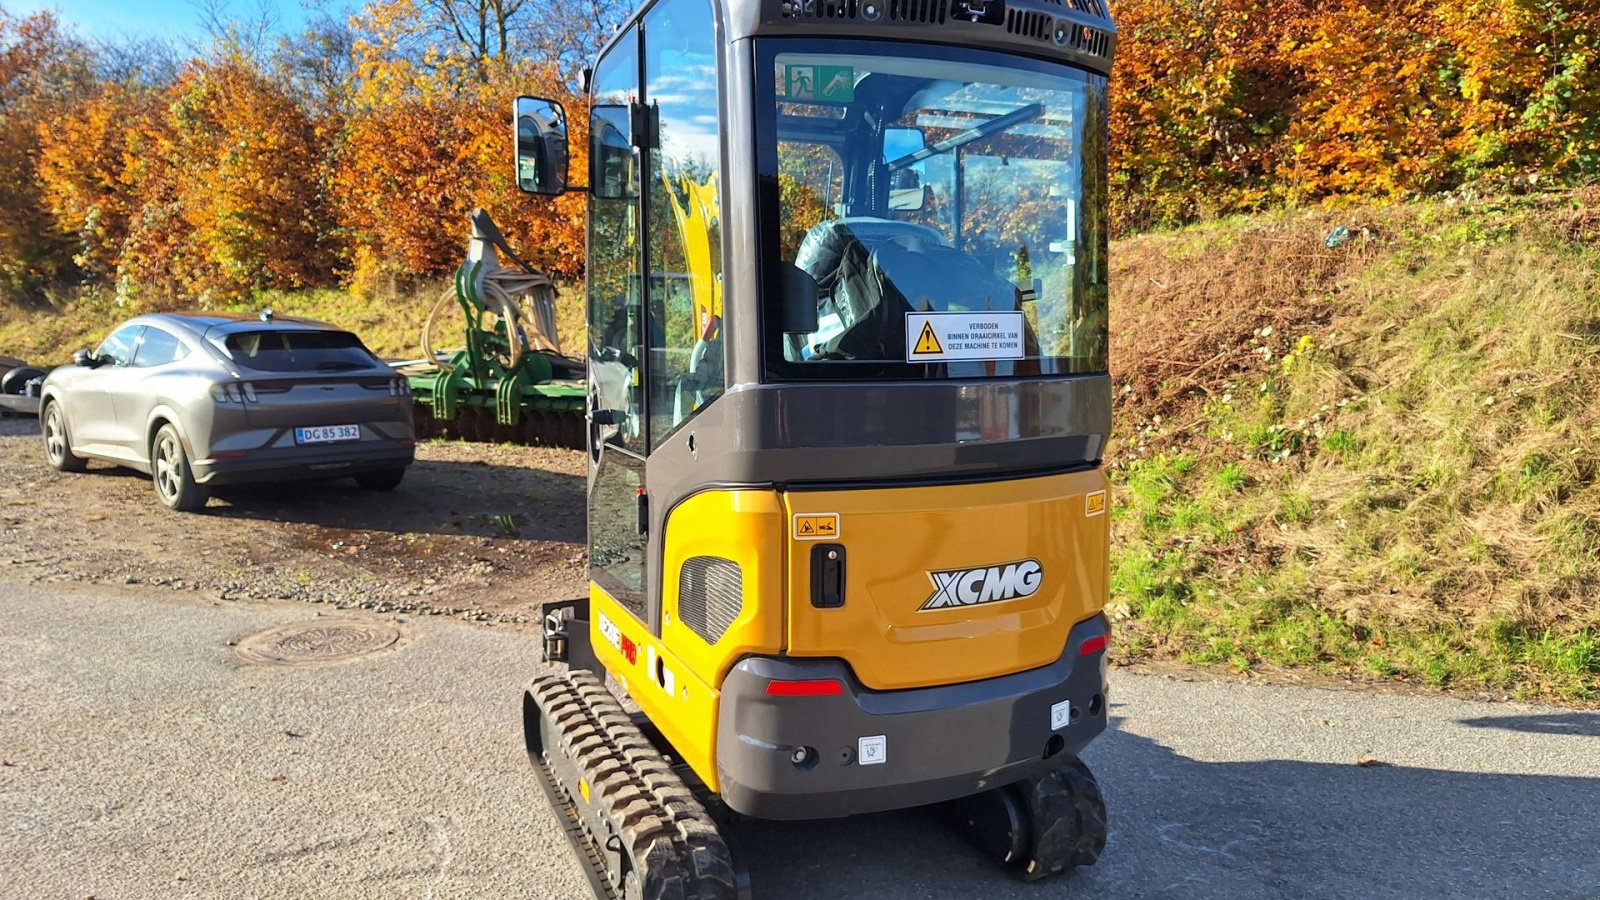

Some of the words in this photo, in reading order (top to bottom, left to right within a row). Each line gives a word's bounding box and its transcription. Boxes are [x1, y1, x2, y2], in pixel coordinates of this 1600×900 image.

[304, 429, 320, 440] DG
[322, 428, 335, 439] 85
[337, 427, 357, 438] 382
[924, 560, 1042, 609] XCMG
